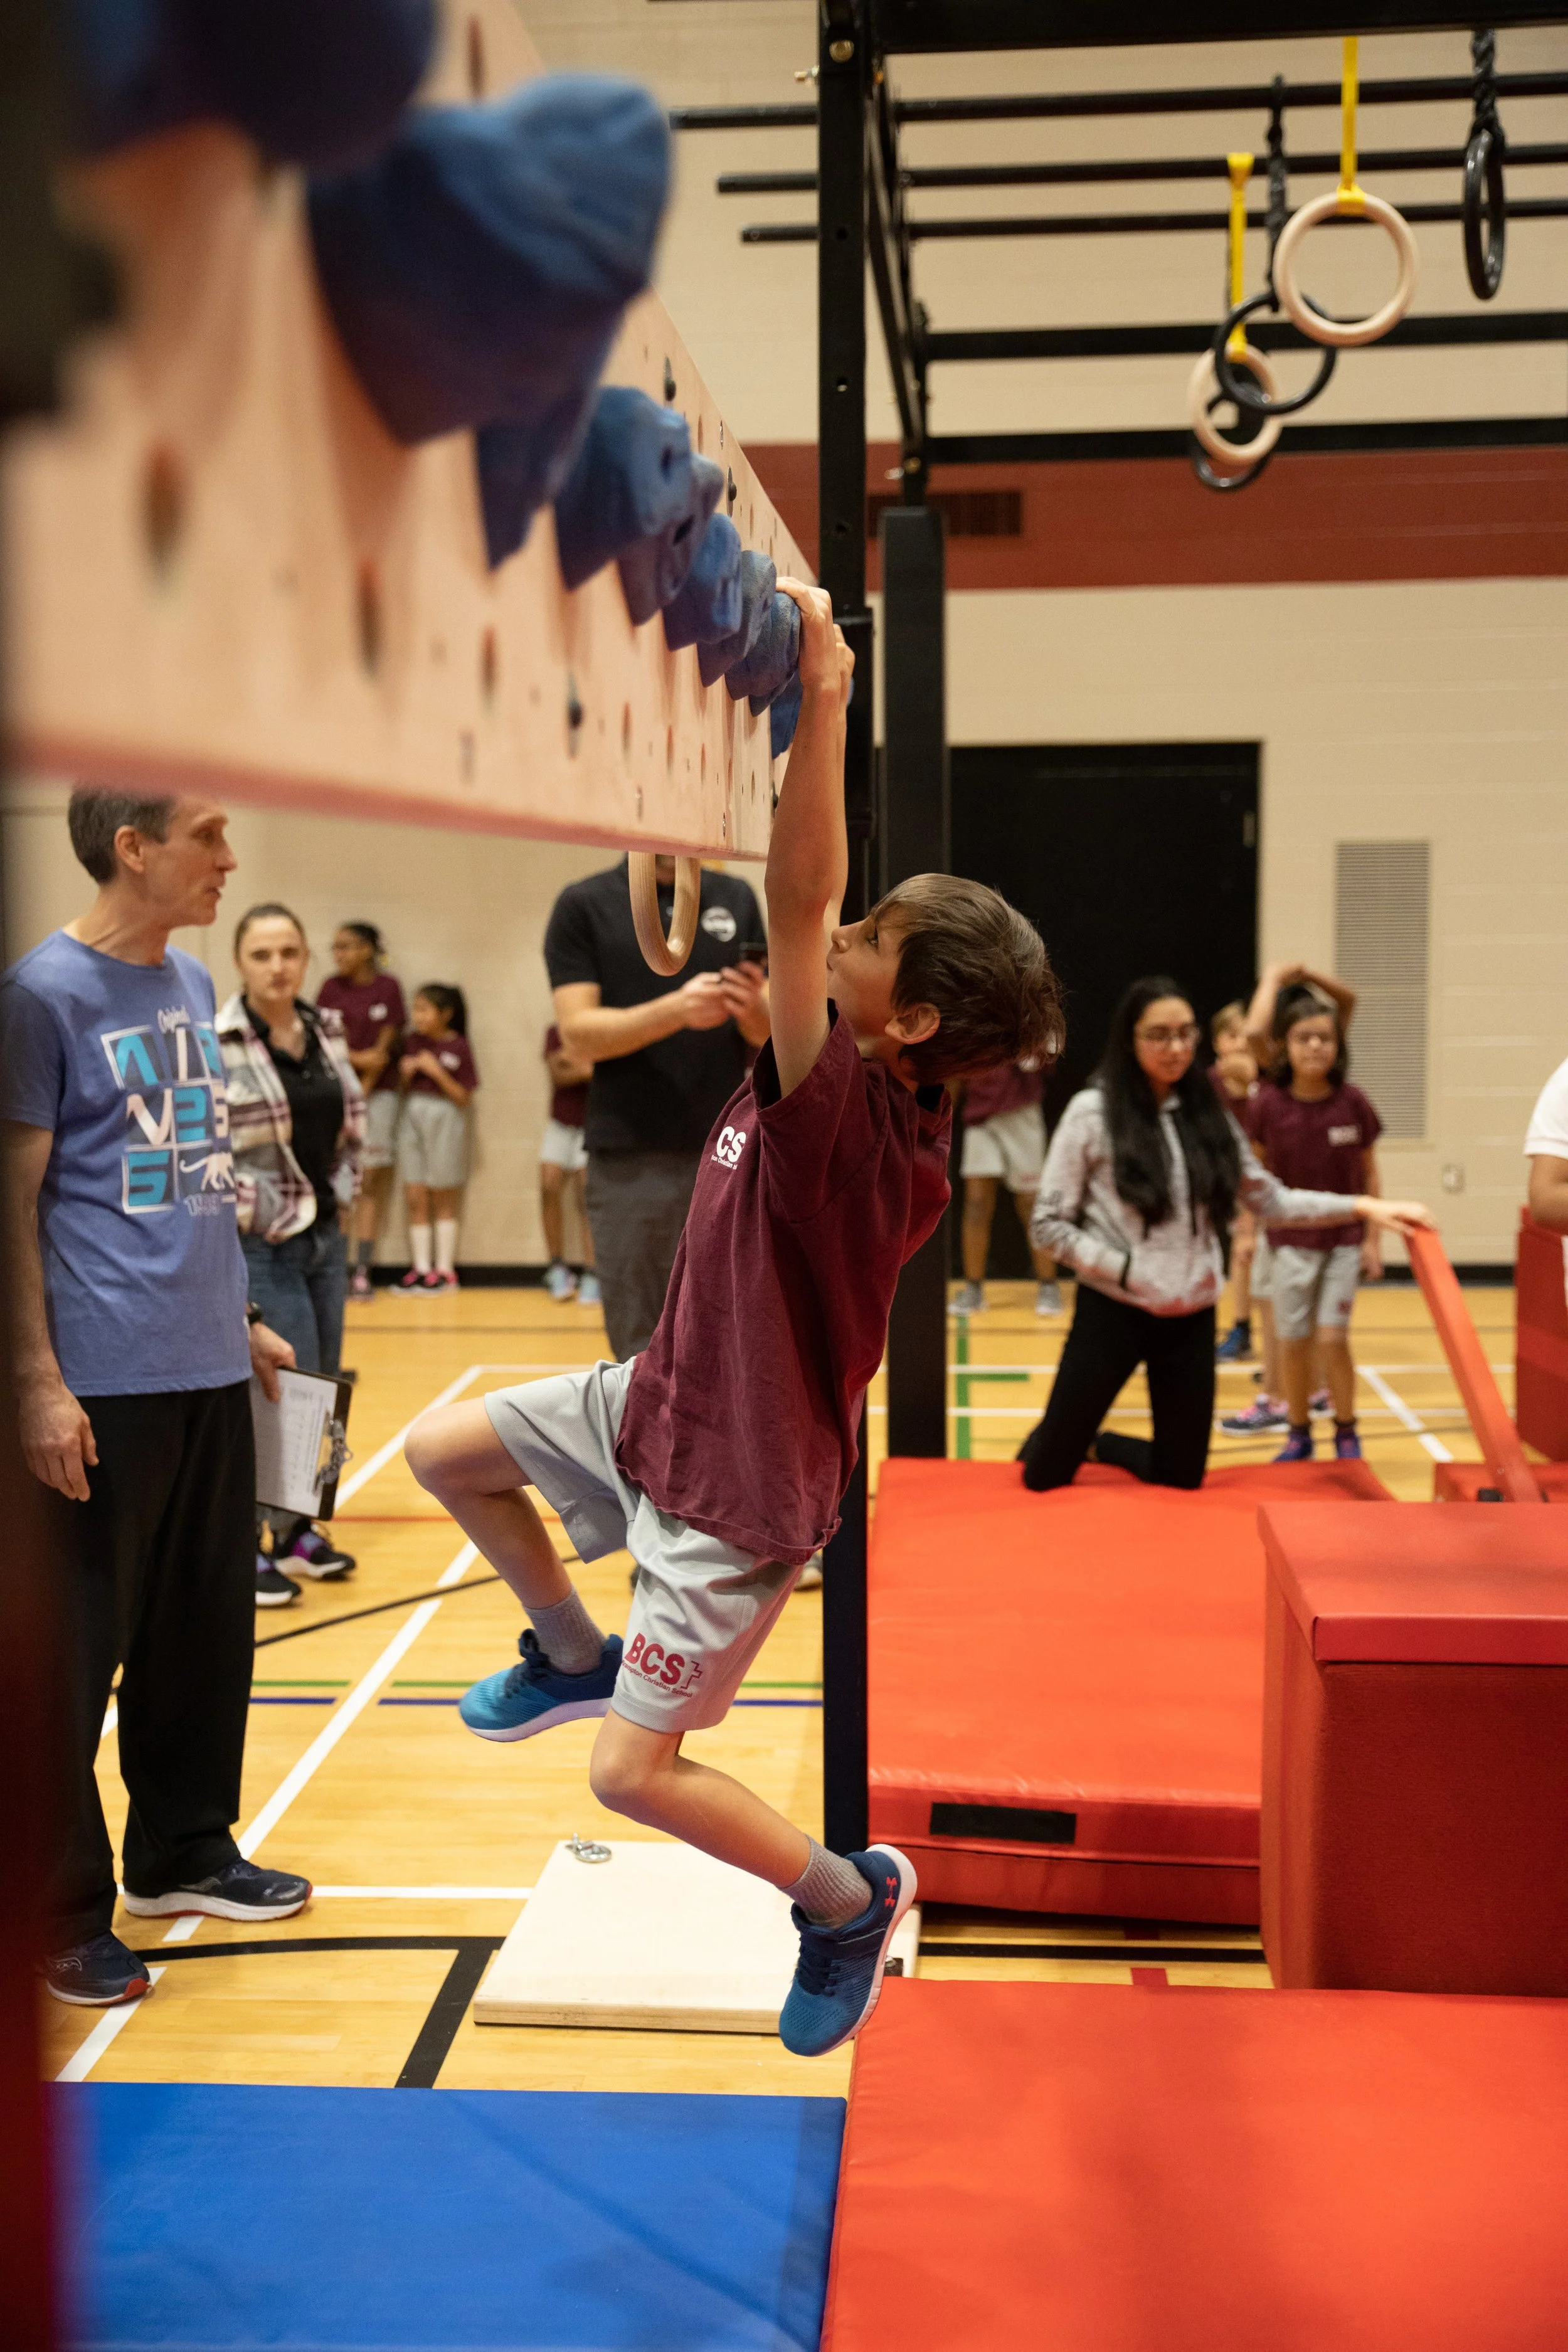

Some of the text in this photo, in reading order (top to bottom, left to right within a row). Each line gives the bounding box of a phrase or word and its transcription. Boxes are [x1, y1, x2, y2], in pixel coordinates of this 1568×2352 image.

[625, 1633, 685, 1685] BCS
[643, 1675, 670, 1692] Christian
[671, 1687, 693, 1698] School
